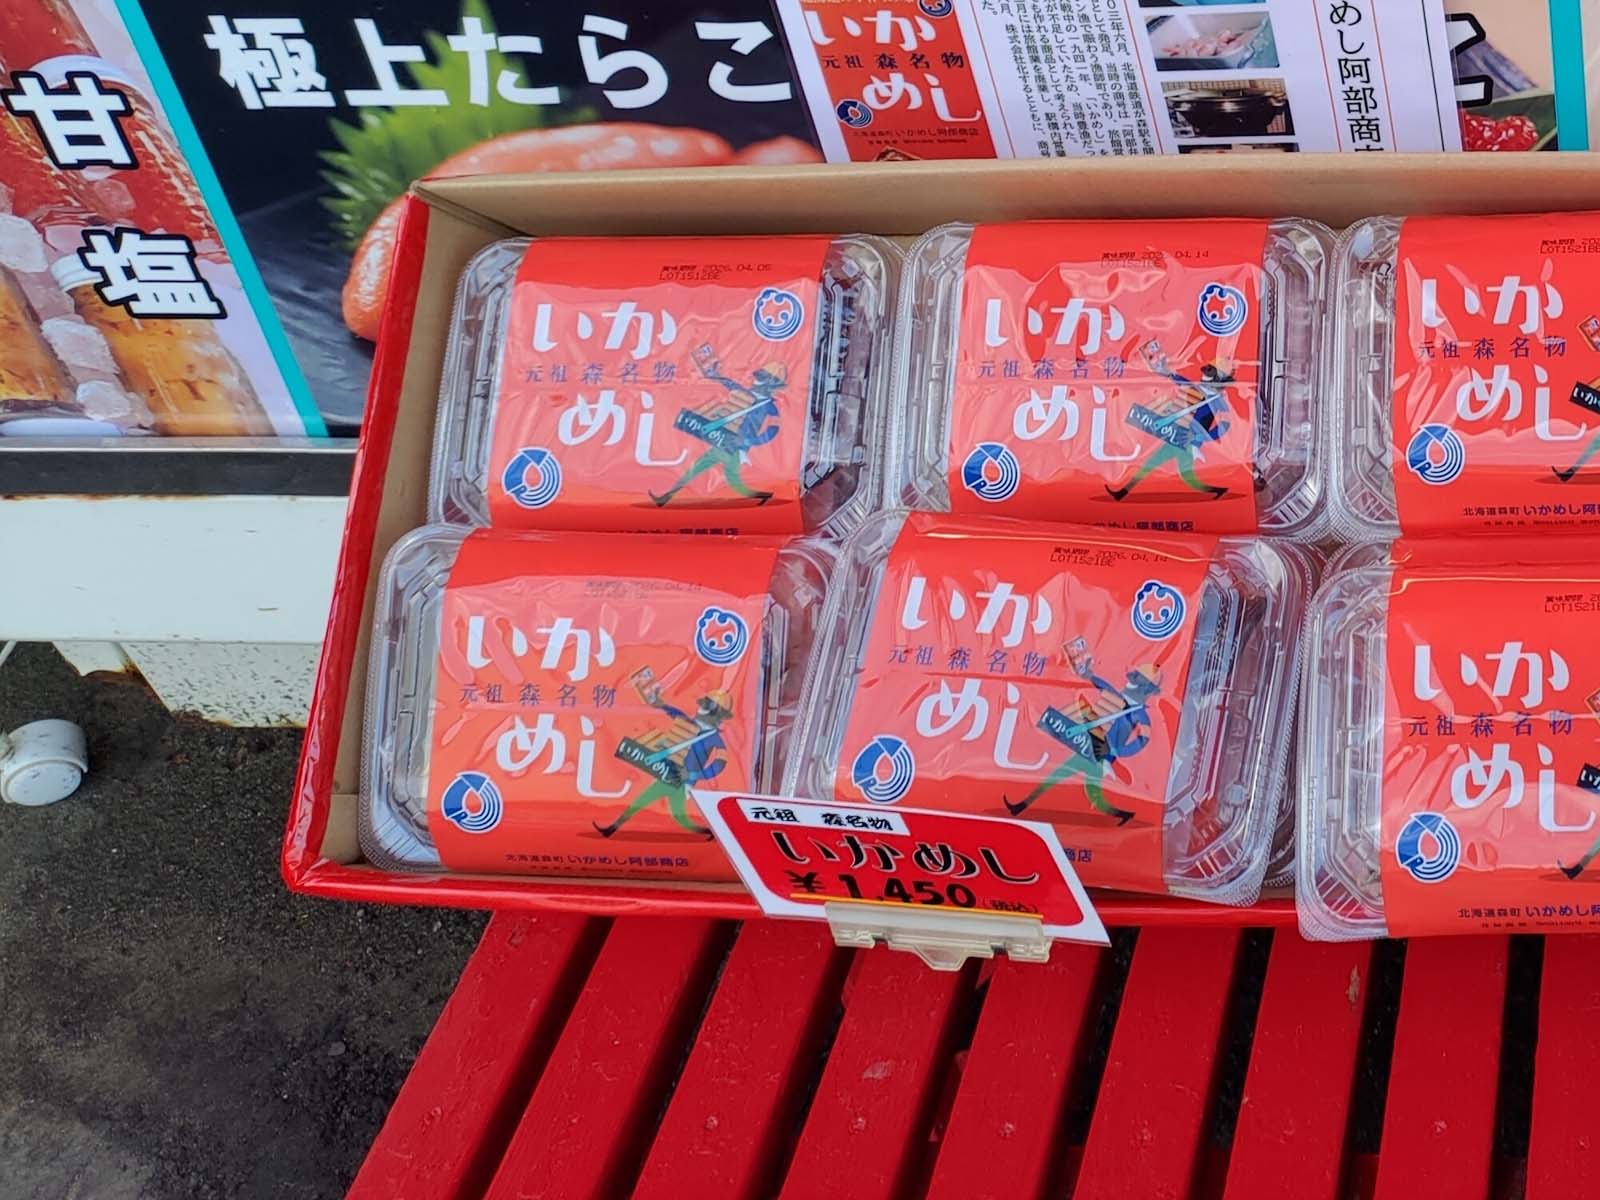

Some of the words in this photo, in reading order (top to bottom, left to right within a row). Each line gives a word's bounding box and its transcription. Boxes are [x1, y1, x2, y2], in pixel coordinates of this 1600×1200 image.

[202, 12, 794, 111] 極上たらこ
[804, 9, 937, 52] いか
[862, 72, 982, 123] めし
[532, 301, 678, 361] いか
[984, 297, 1126, 356] いか
[1421, 275, 1565, 335] いか
[557, 389, 689, 467] めし
[1012, 384, 1142, 462] めし
[1456, 363, 1588, 442] めし
[901, 576, 1053, 647] いか
[465, 615, 617, 682] いか
[1413, 641, 1571, 709] いか
[495, 712, 632, 798] めし
[916, 679, 1050, 771] めし
[751, 806, 799, 823] 元祖
[821, 812, 894, 832] 森名物
[1450, 742, 1596, 834] めし
[769, 830, 1041, 886] いかめし
